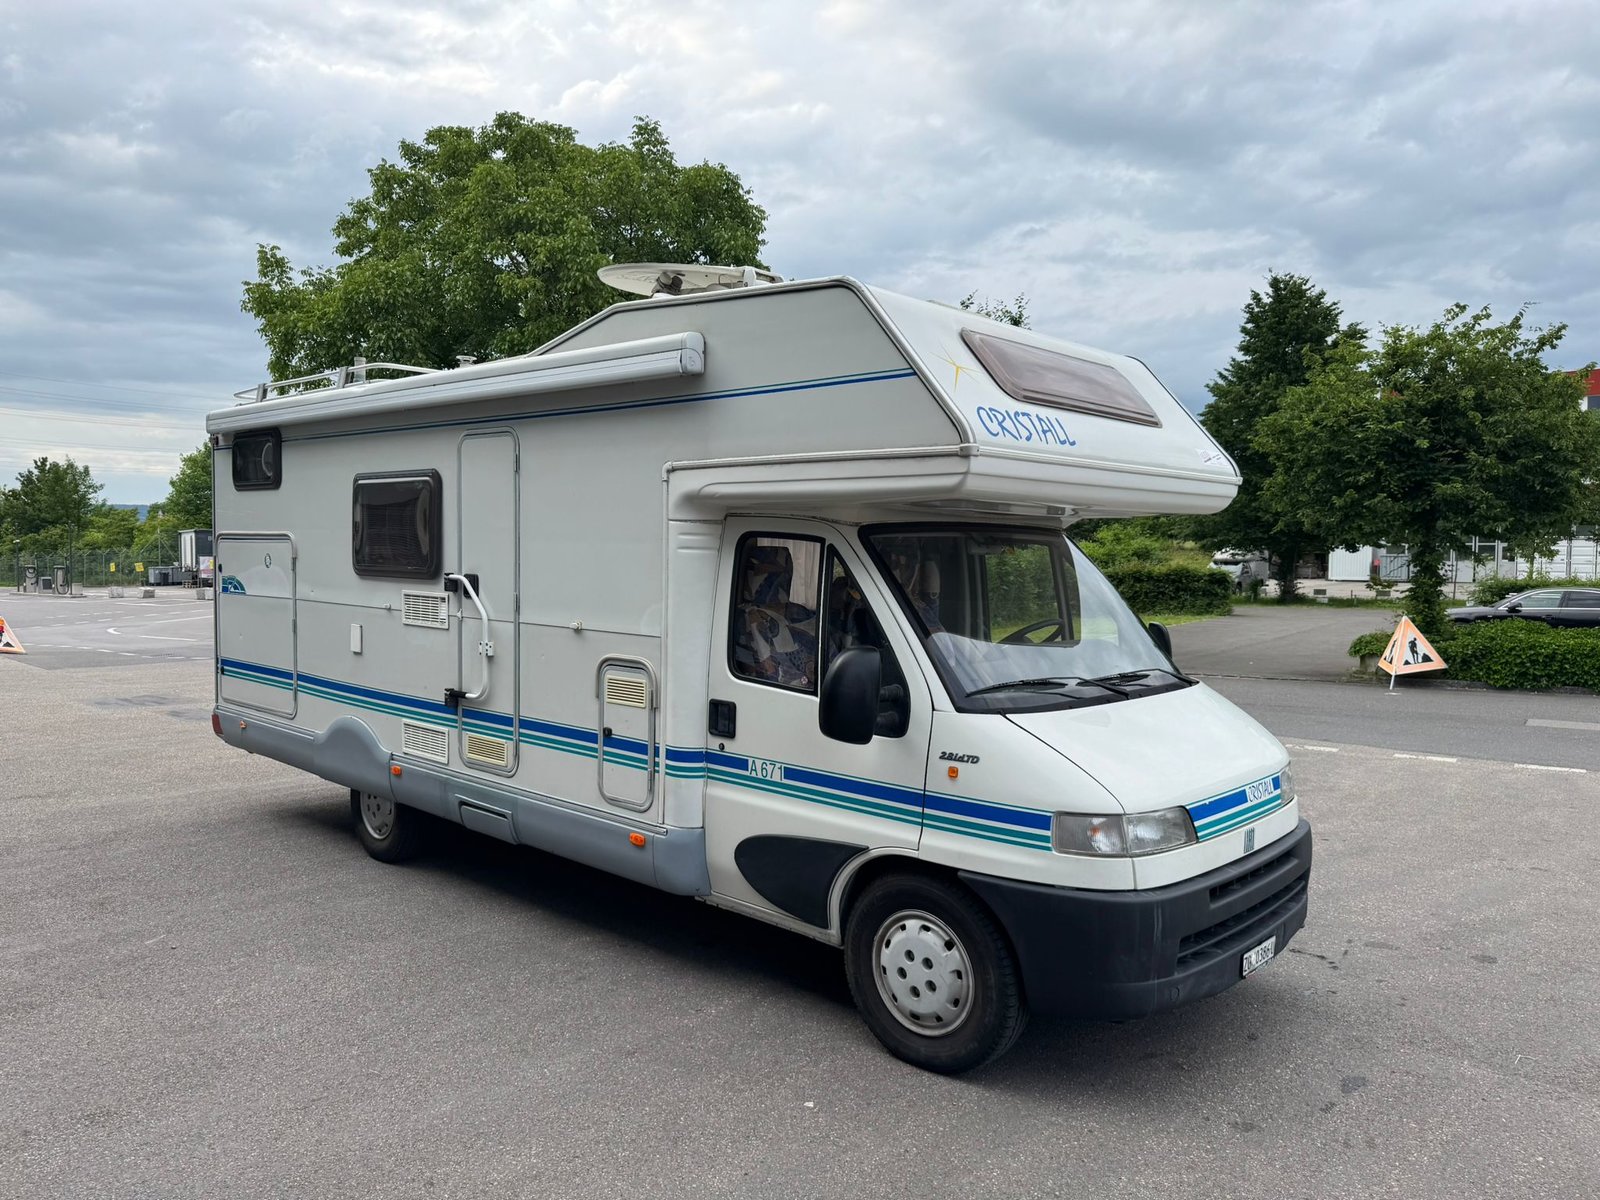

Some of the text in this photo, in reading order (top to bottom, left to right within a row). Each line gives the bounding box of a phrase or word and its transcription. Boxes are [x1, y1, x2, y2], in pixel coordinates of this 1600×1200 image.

[976, 406, 1076, 446] CRISTALL
[749, 759, 783, 781] A 671
[1247, 778, 1274, 803] CRISTALL
